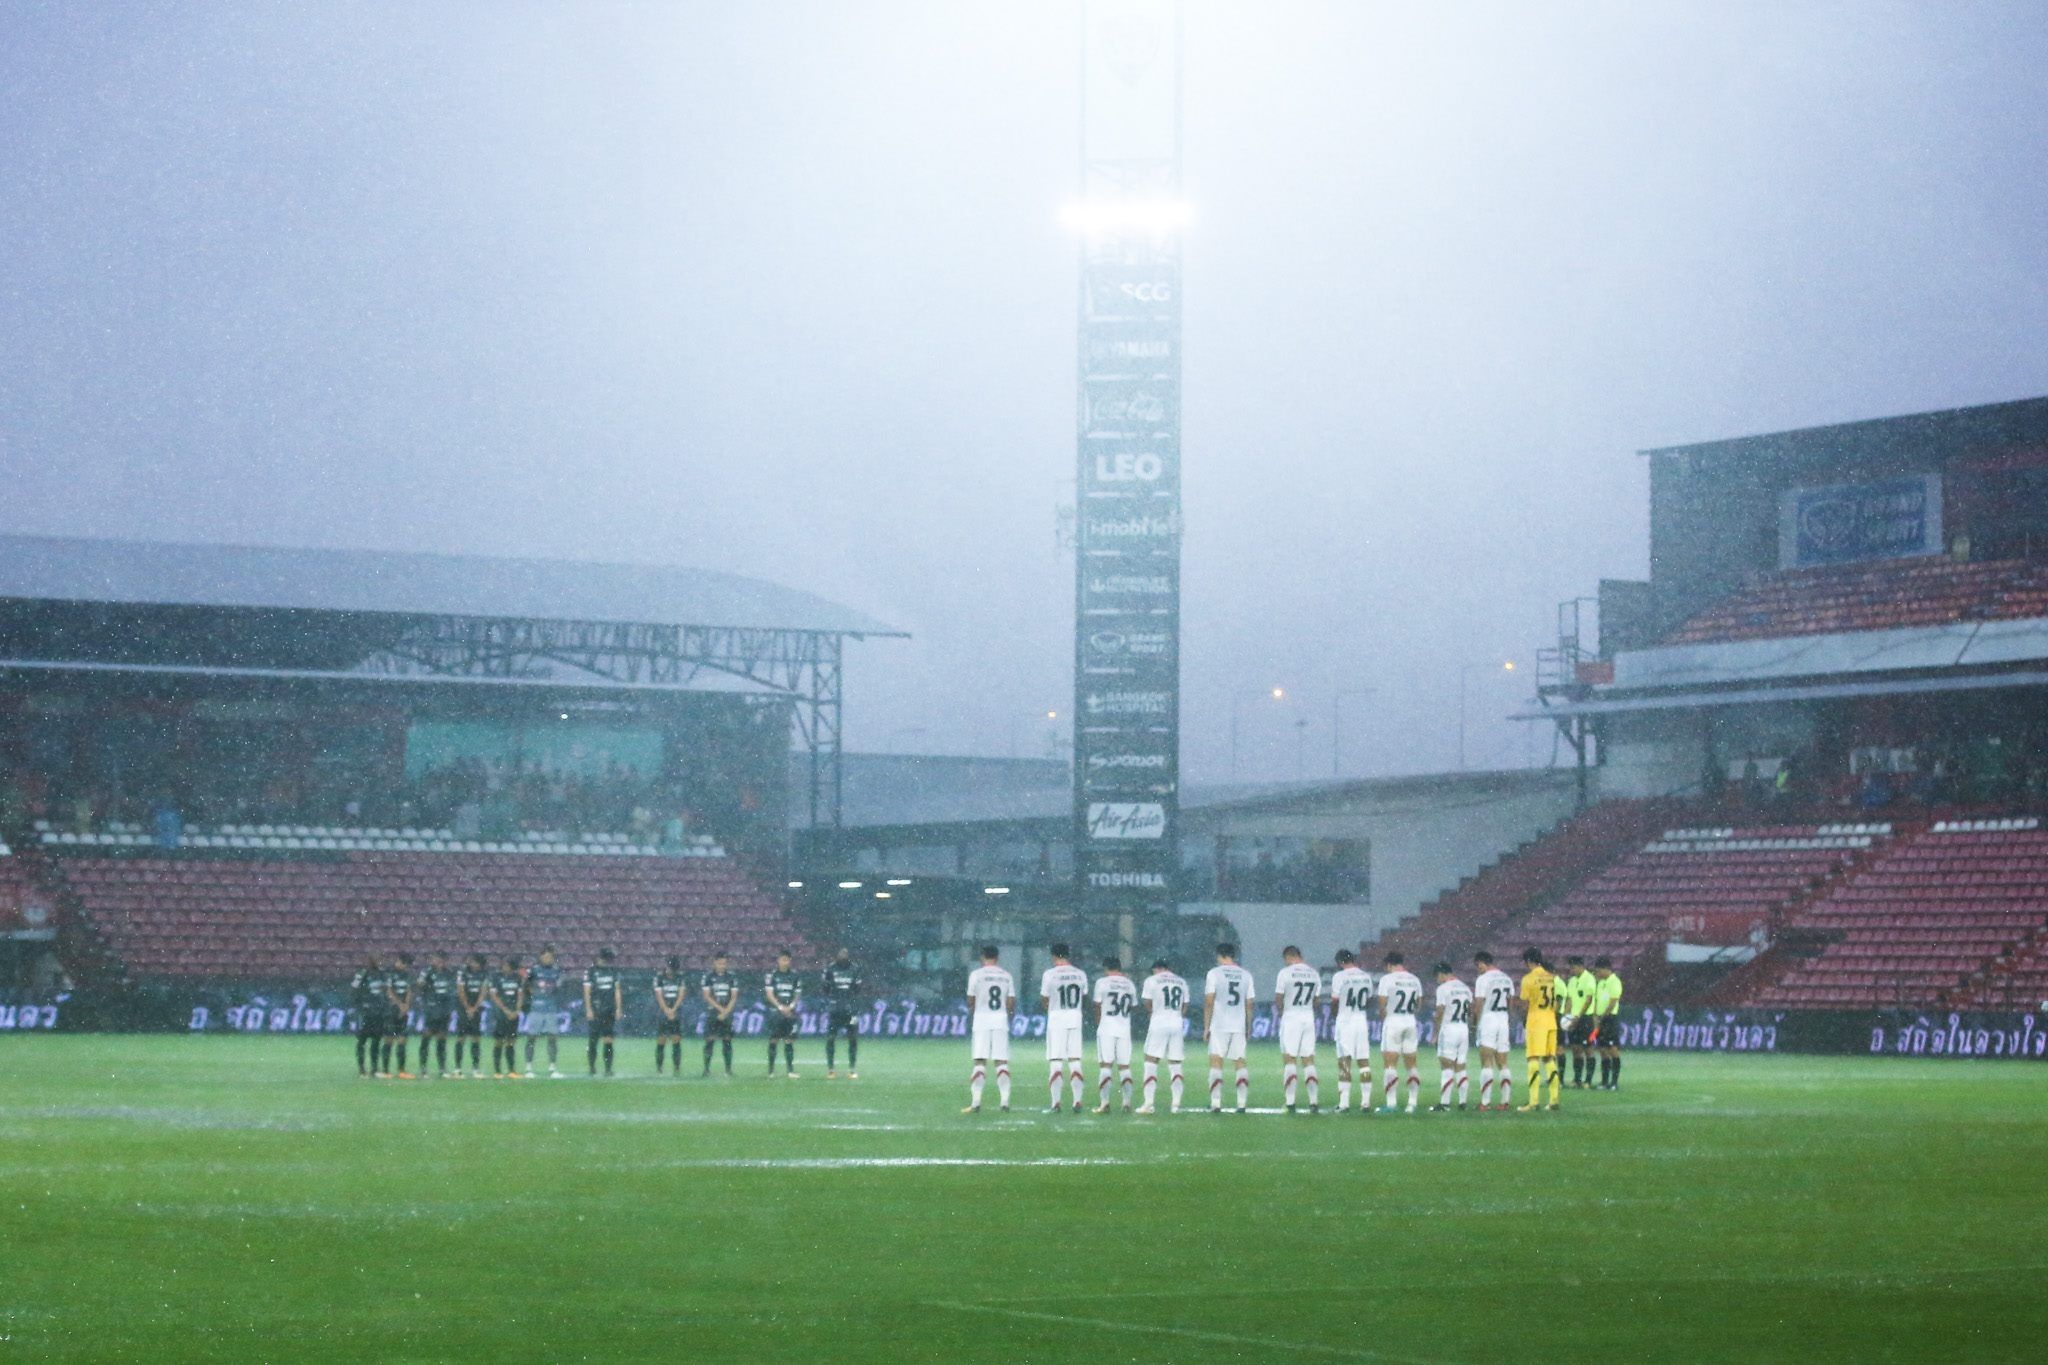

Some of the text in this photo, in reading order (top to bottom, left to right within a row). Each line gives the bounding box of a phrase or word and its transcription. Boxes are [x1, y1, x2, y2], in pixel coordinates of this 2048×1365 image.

[1120, 281, 1171, 301] SCG
[1096, 452, 1162, 481] LEO
[1088, 872, 1165, 887] TOSHIBA
[989, 985, 1001, 1011] 8
[1057, 983, 1081, 1010] 10
[1106, 991, 1133, 1018] 30
[1162, 985, 1182, 1011] 18
[1227, 981, 1241, 1007] 5
[1346, 986, 1370, 1013] 40
[1394, 989, 1418, 1015] 26
